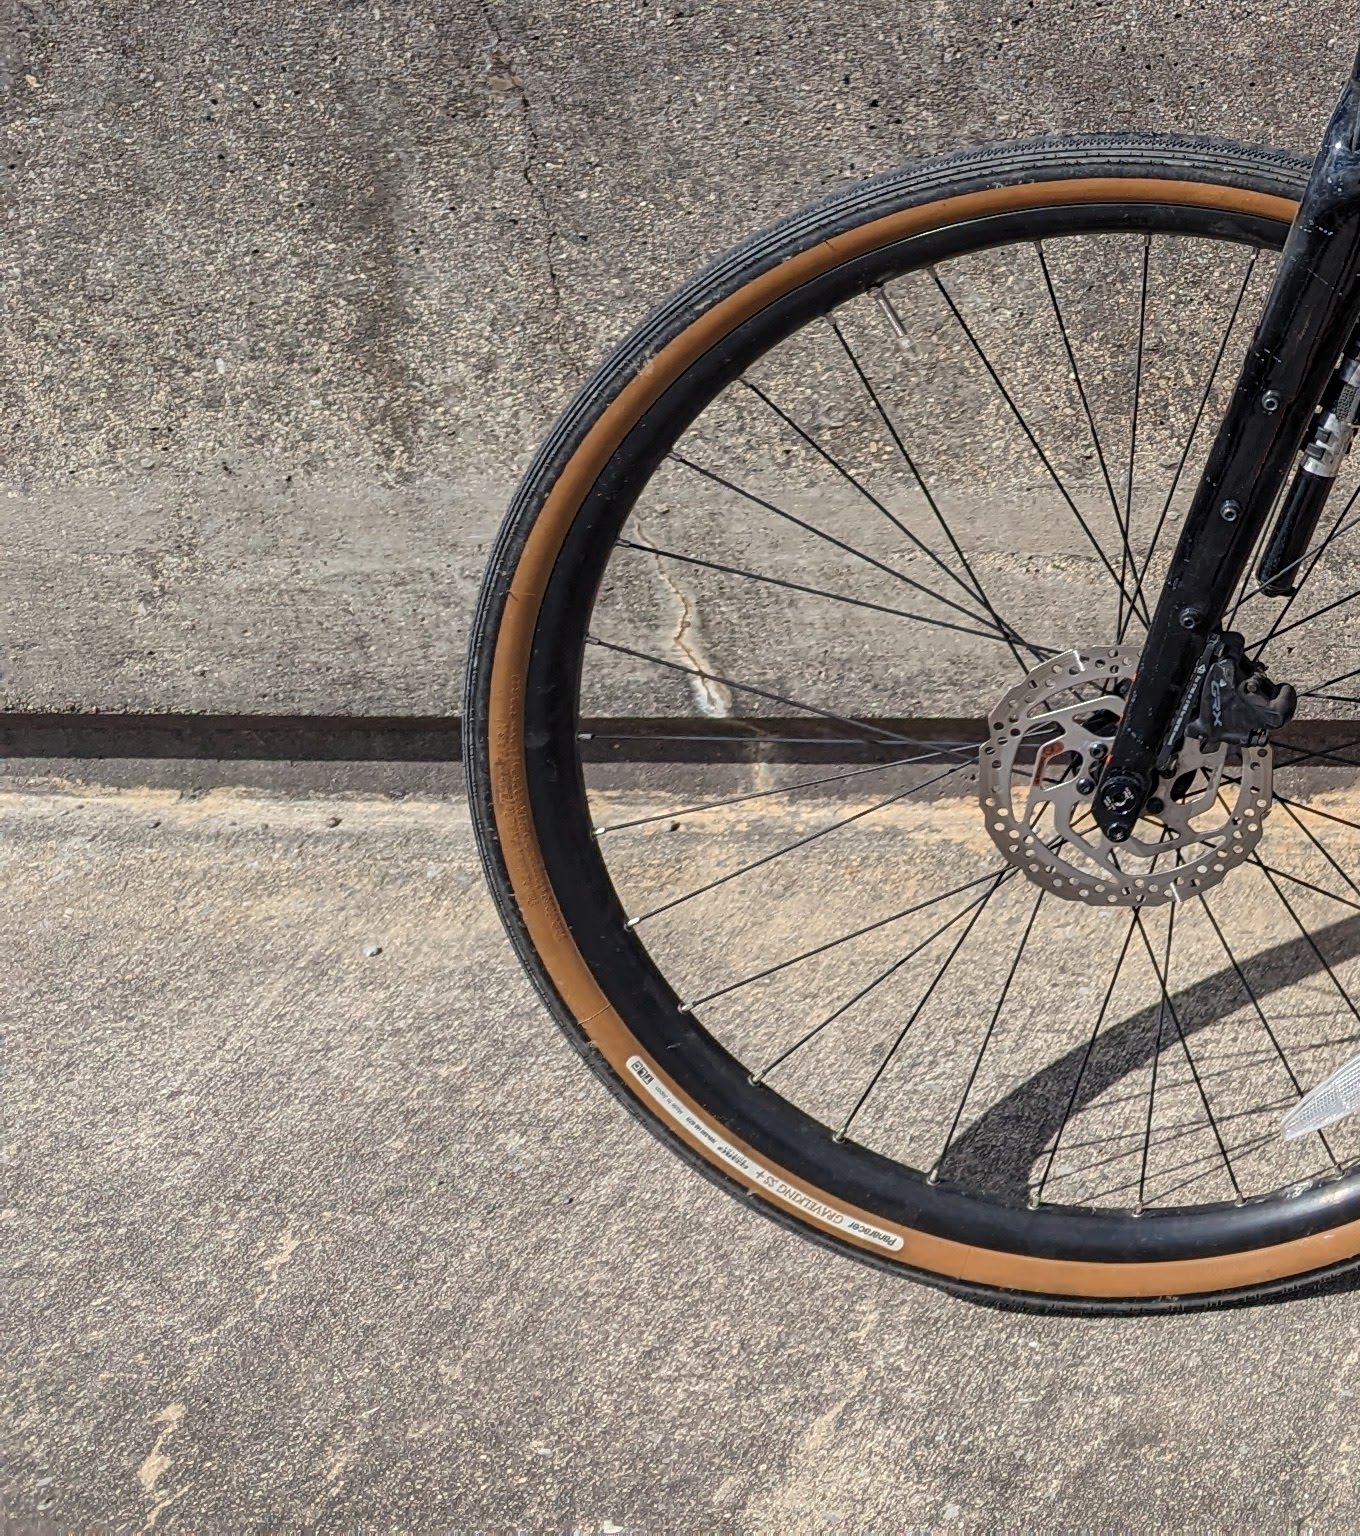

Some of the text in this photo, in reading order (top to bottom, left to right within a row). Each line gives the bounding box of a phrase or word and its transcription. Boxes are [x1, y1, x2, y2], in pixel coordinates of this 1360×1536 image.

[1211, 680, 1223, 727] GRX
[631, 1060, 655, 1085] TLC
[775, 1183, 844, 1225] GRAVELKING
[847, 1221, 898, 1247] Panaracer
